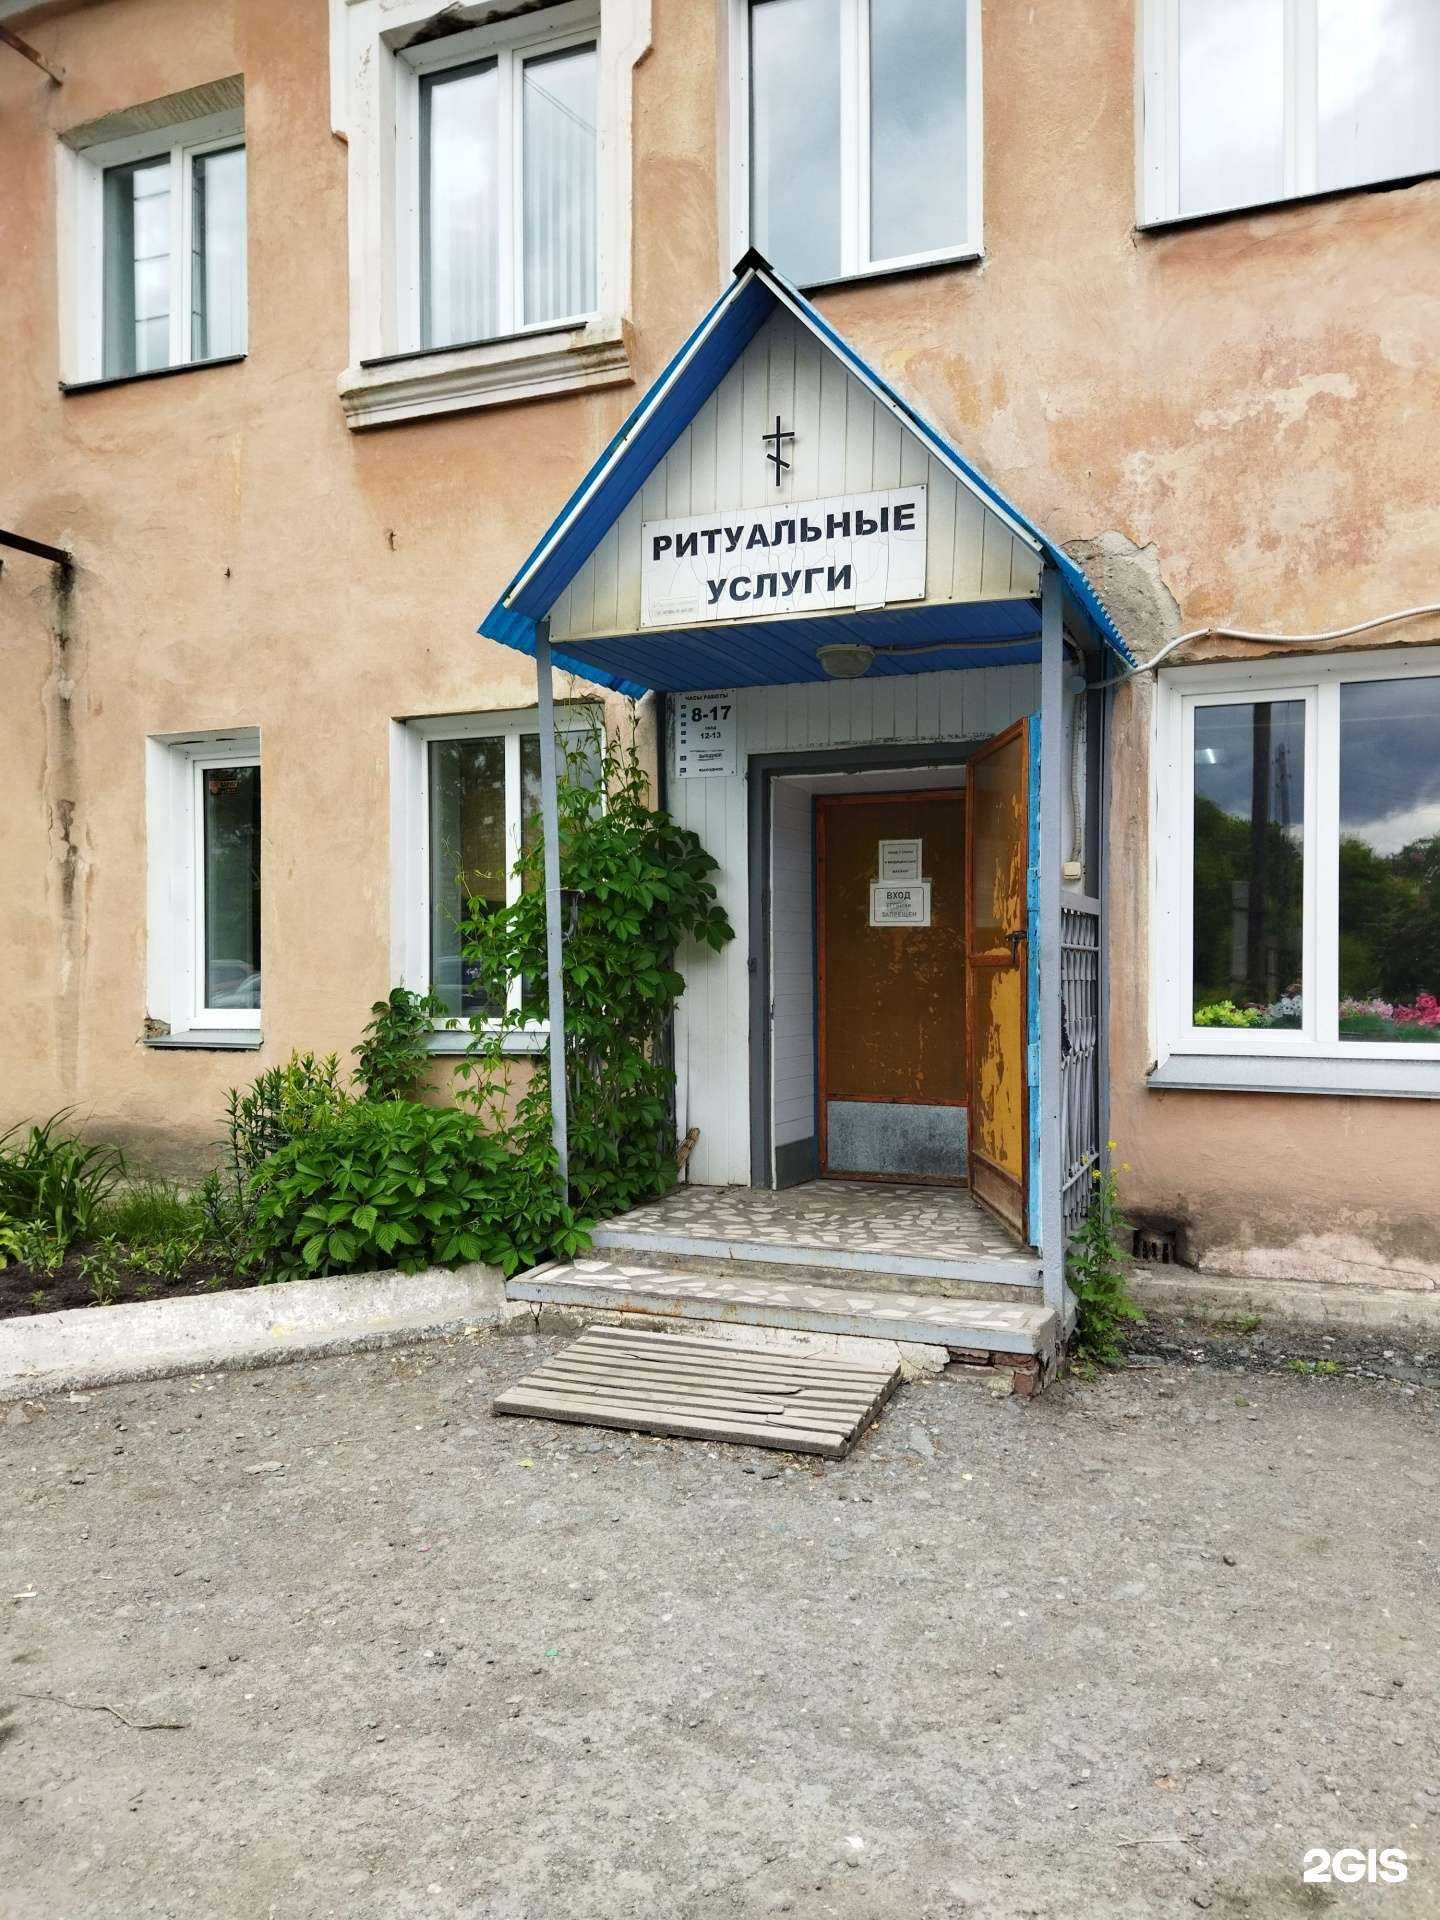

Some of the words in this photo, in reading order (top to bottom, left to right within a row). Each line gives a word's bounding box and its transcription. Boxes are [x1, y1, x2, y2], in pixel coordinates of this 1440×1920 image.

[653, 503, 916, 561] РИТУАЛЬНЫЕ
[707, 565, 852, 605] УСЛУГИ
[691, 704, 732, 722] 8-17
[700, 731, 721, 740] 12-13
[886, 891, 912, 901] ВХОД
